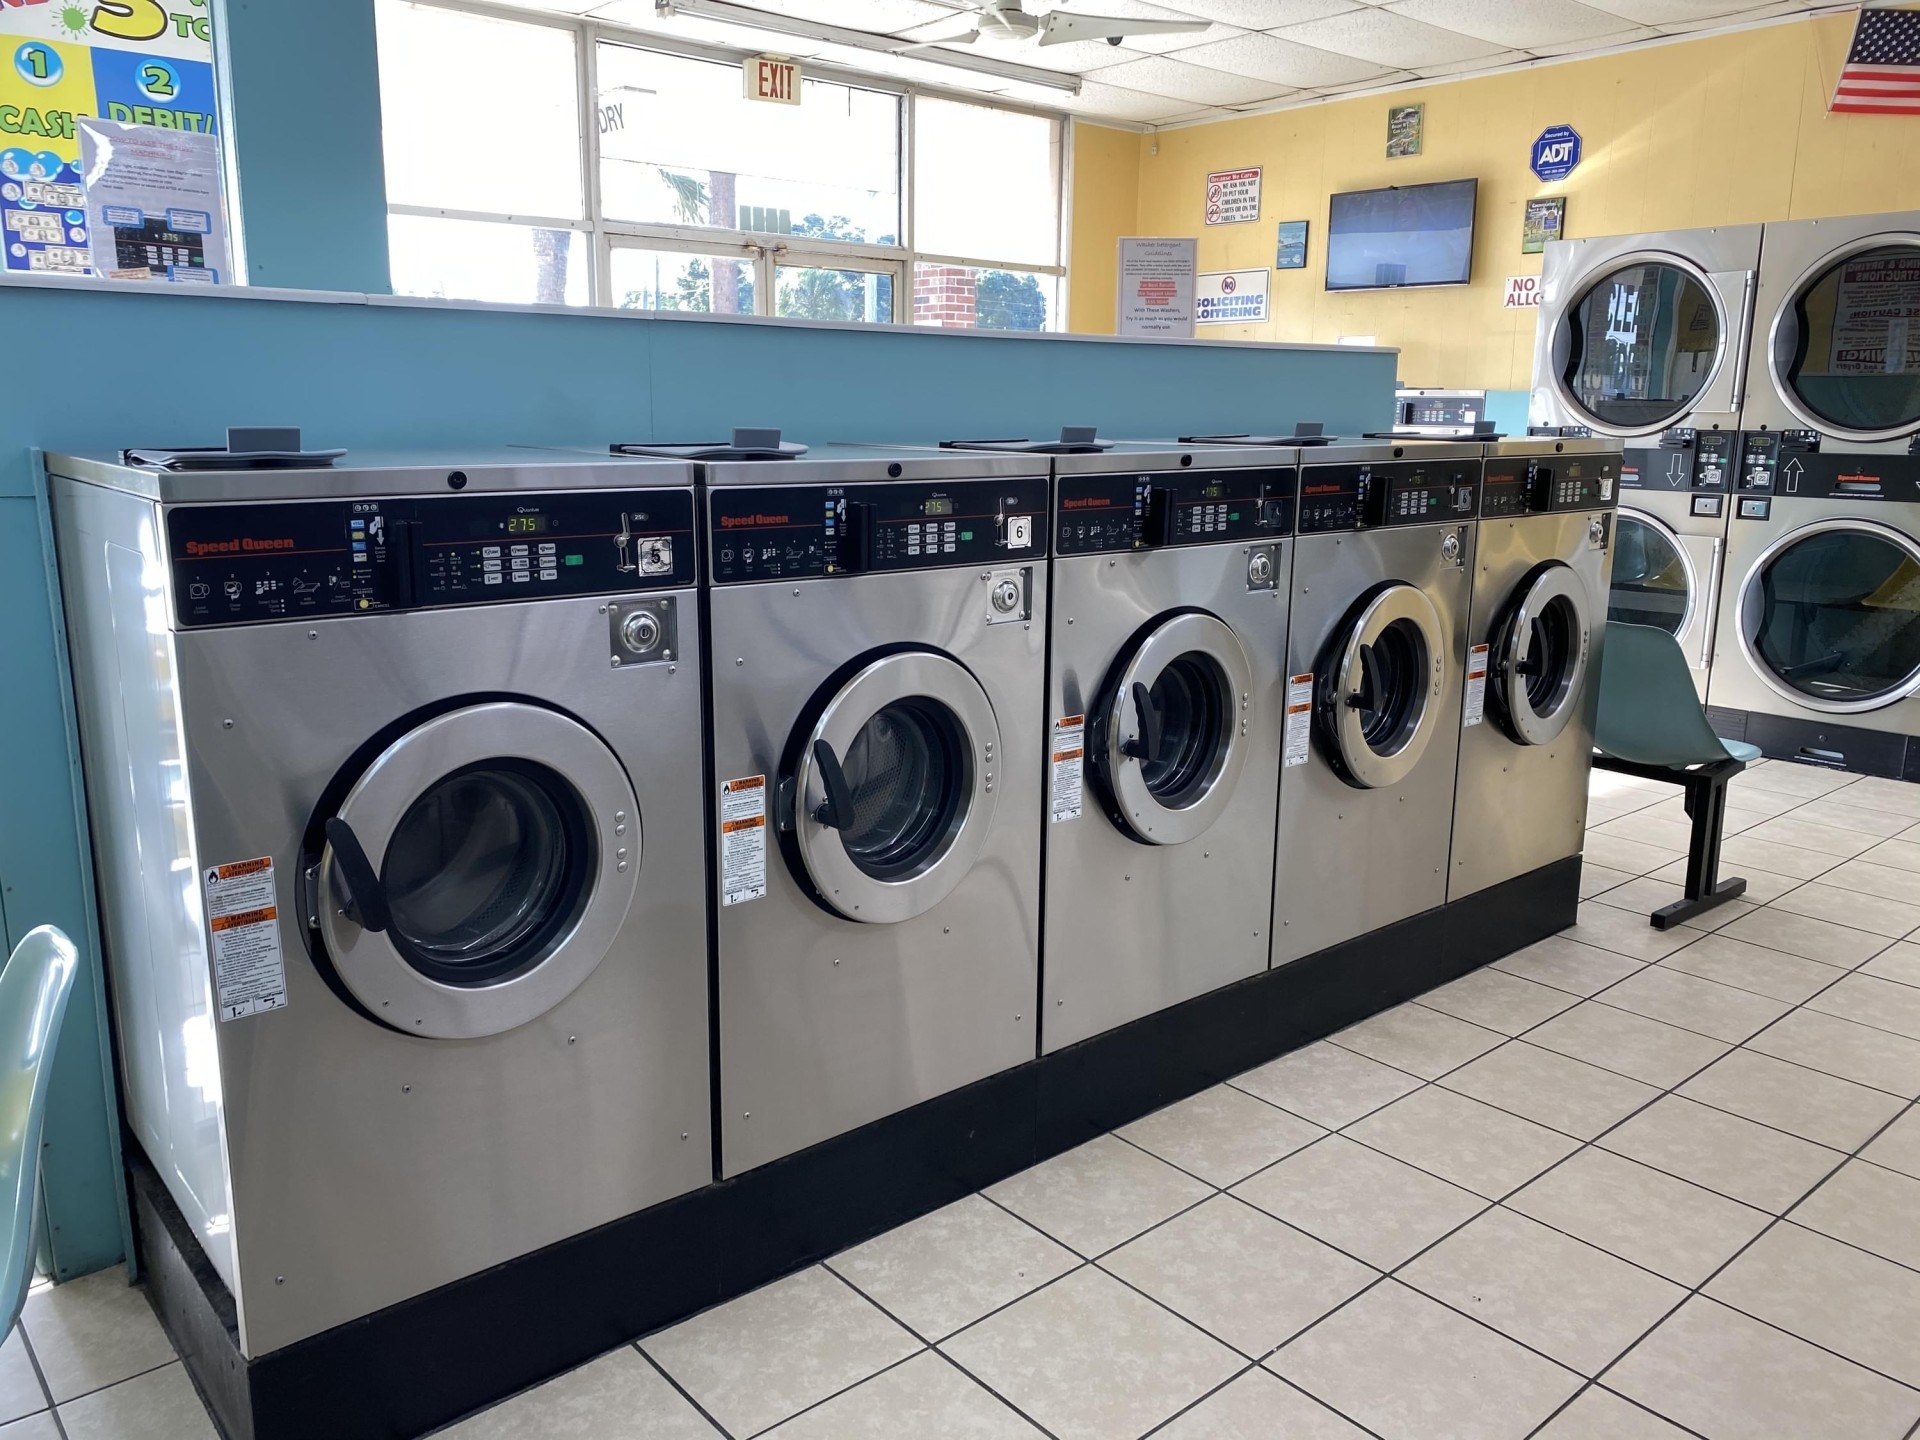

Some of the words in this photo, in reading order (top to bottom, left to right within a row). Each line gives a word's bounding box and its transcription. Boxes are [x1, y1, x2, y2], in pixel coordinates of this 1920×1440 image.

[28, 50, 48, 78] 1
[144, 66, 174, 96] 2
[758, 62, 794, 100] EXIT
[1538, 142, 1573, 164] ADT
[1513, 278, 1535, 292] NO
[508, 518, 536, 532] 275
[721, 515, 755, 528] Speed
[756, 514, 789, 524] Queen
[1016, 526, 1023, 538] 6
[186, 539, 240, 556] Speed
[242, 538, 294, 550] Queen
[651, 549, 661, 564] 5
[230, 910, 264, 922] WARNING
